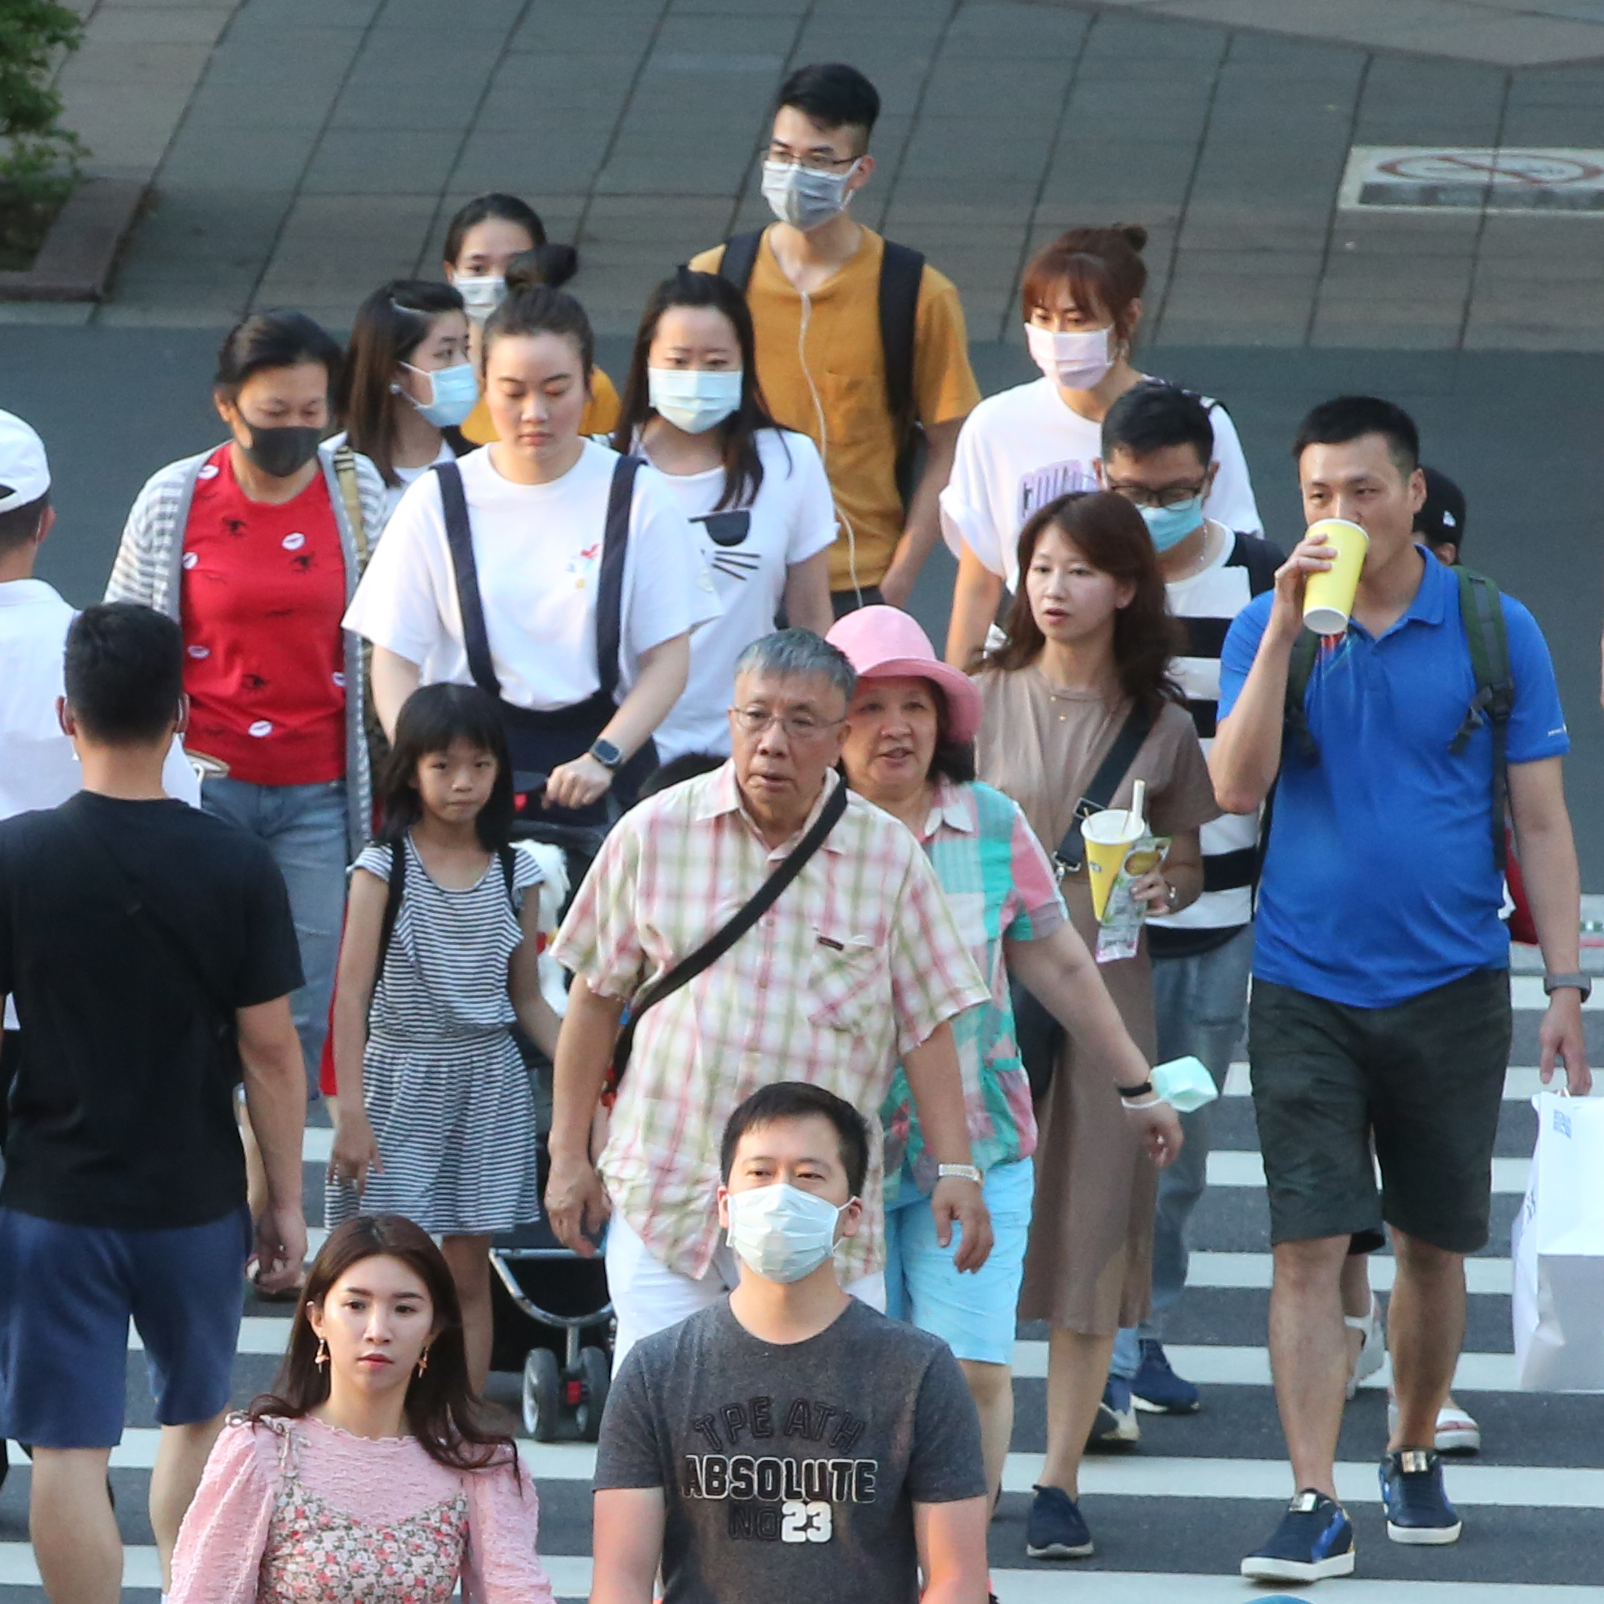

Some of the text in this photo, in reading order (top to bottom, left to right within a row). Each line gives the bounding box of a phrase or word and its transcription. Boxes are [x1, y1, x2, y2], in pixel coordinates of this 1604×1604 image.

[695, 1396, 867, 1453] TPE ATH
[681, 1454, 878, 1503] ABSOLUTE
[781, 1501, 832, 1543] 23
